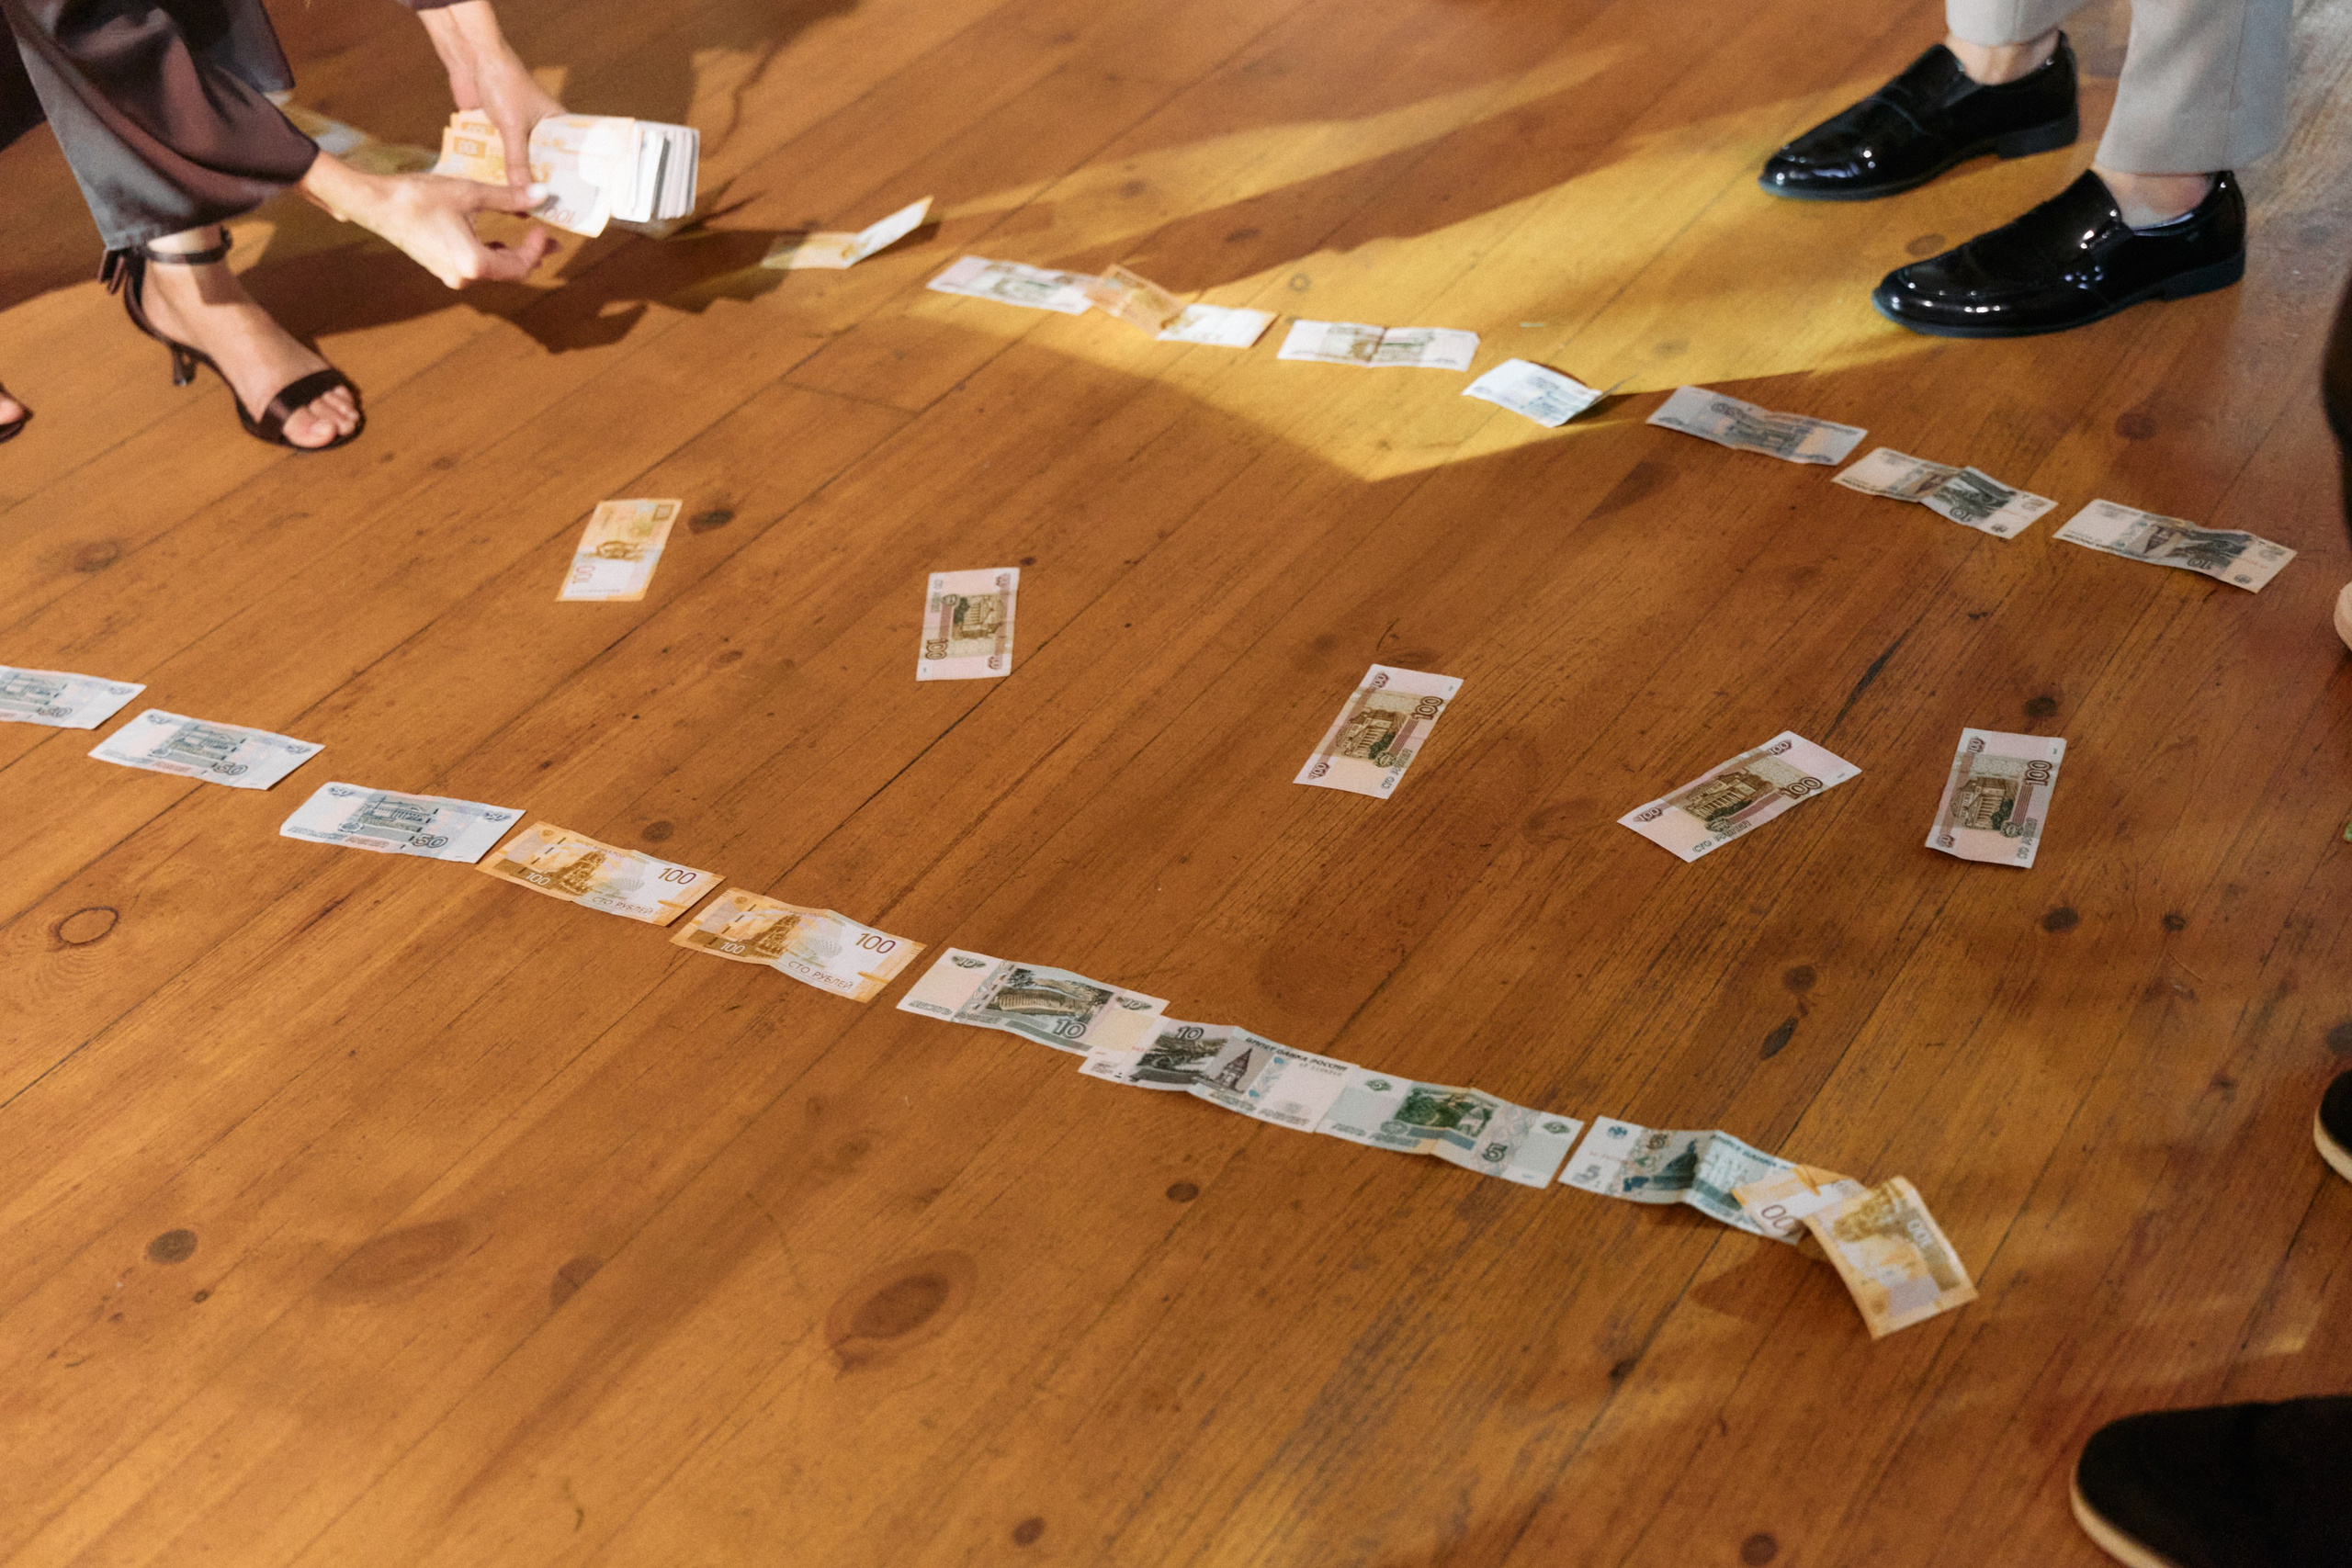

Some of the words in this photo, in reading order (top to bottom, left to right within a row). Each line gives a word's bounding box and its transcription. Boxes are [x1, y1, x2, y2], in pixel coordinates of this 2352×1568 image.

[925, 638, 949, 660] 100
[1411, 695, 1443, 721] 100
[1768, 739, 1792, 755] 100
[2024, 760, 2052, 786] 100
[1780, 776, 1824, 800] 100
[1638, 807, 1662, 821] 100
[413, 832, 448, 849] 50
[526, 872, 551, 886] 100
[657, 866, 697, 886] 100
[592, 896, 614, 906] СТО
[615, 900, 654, 917] РУБЛЕЙ
[719, 942, 746, 954] 100
[855, 931, 897, 954] 100
[958, 956, 977, 968] 10
[787, 961, 811, 974] СТО
[812, 971, 854, 991] РУБЛЕЙ
[1124, 998, 1144, 1010] 10
[1054, 1019, 1088, 1039] 10
[1175, 1025, 1204, 1041] 10
[1481, 1142, 1508, 1163] 5
[1760, 1204, 1794, 1230] 00
